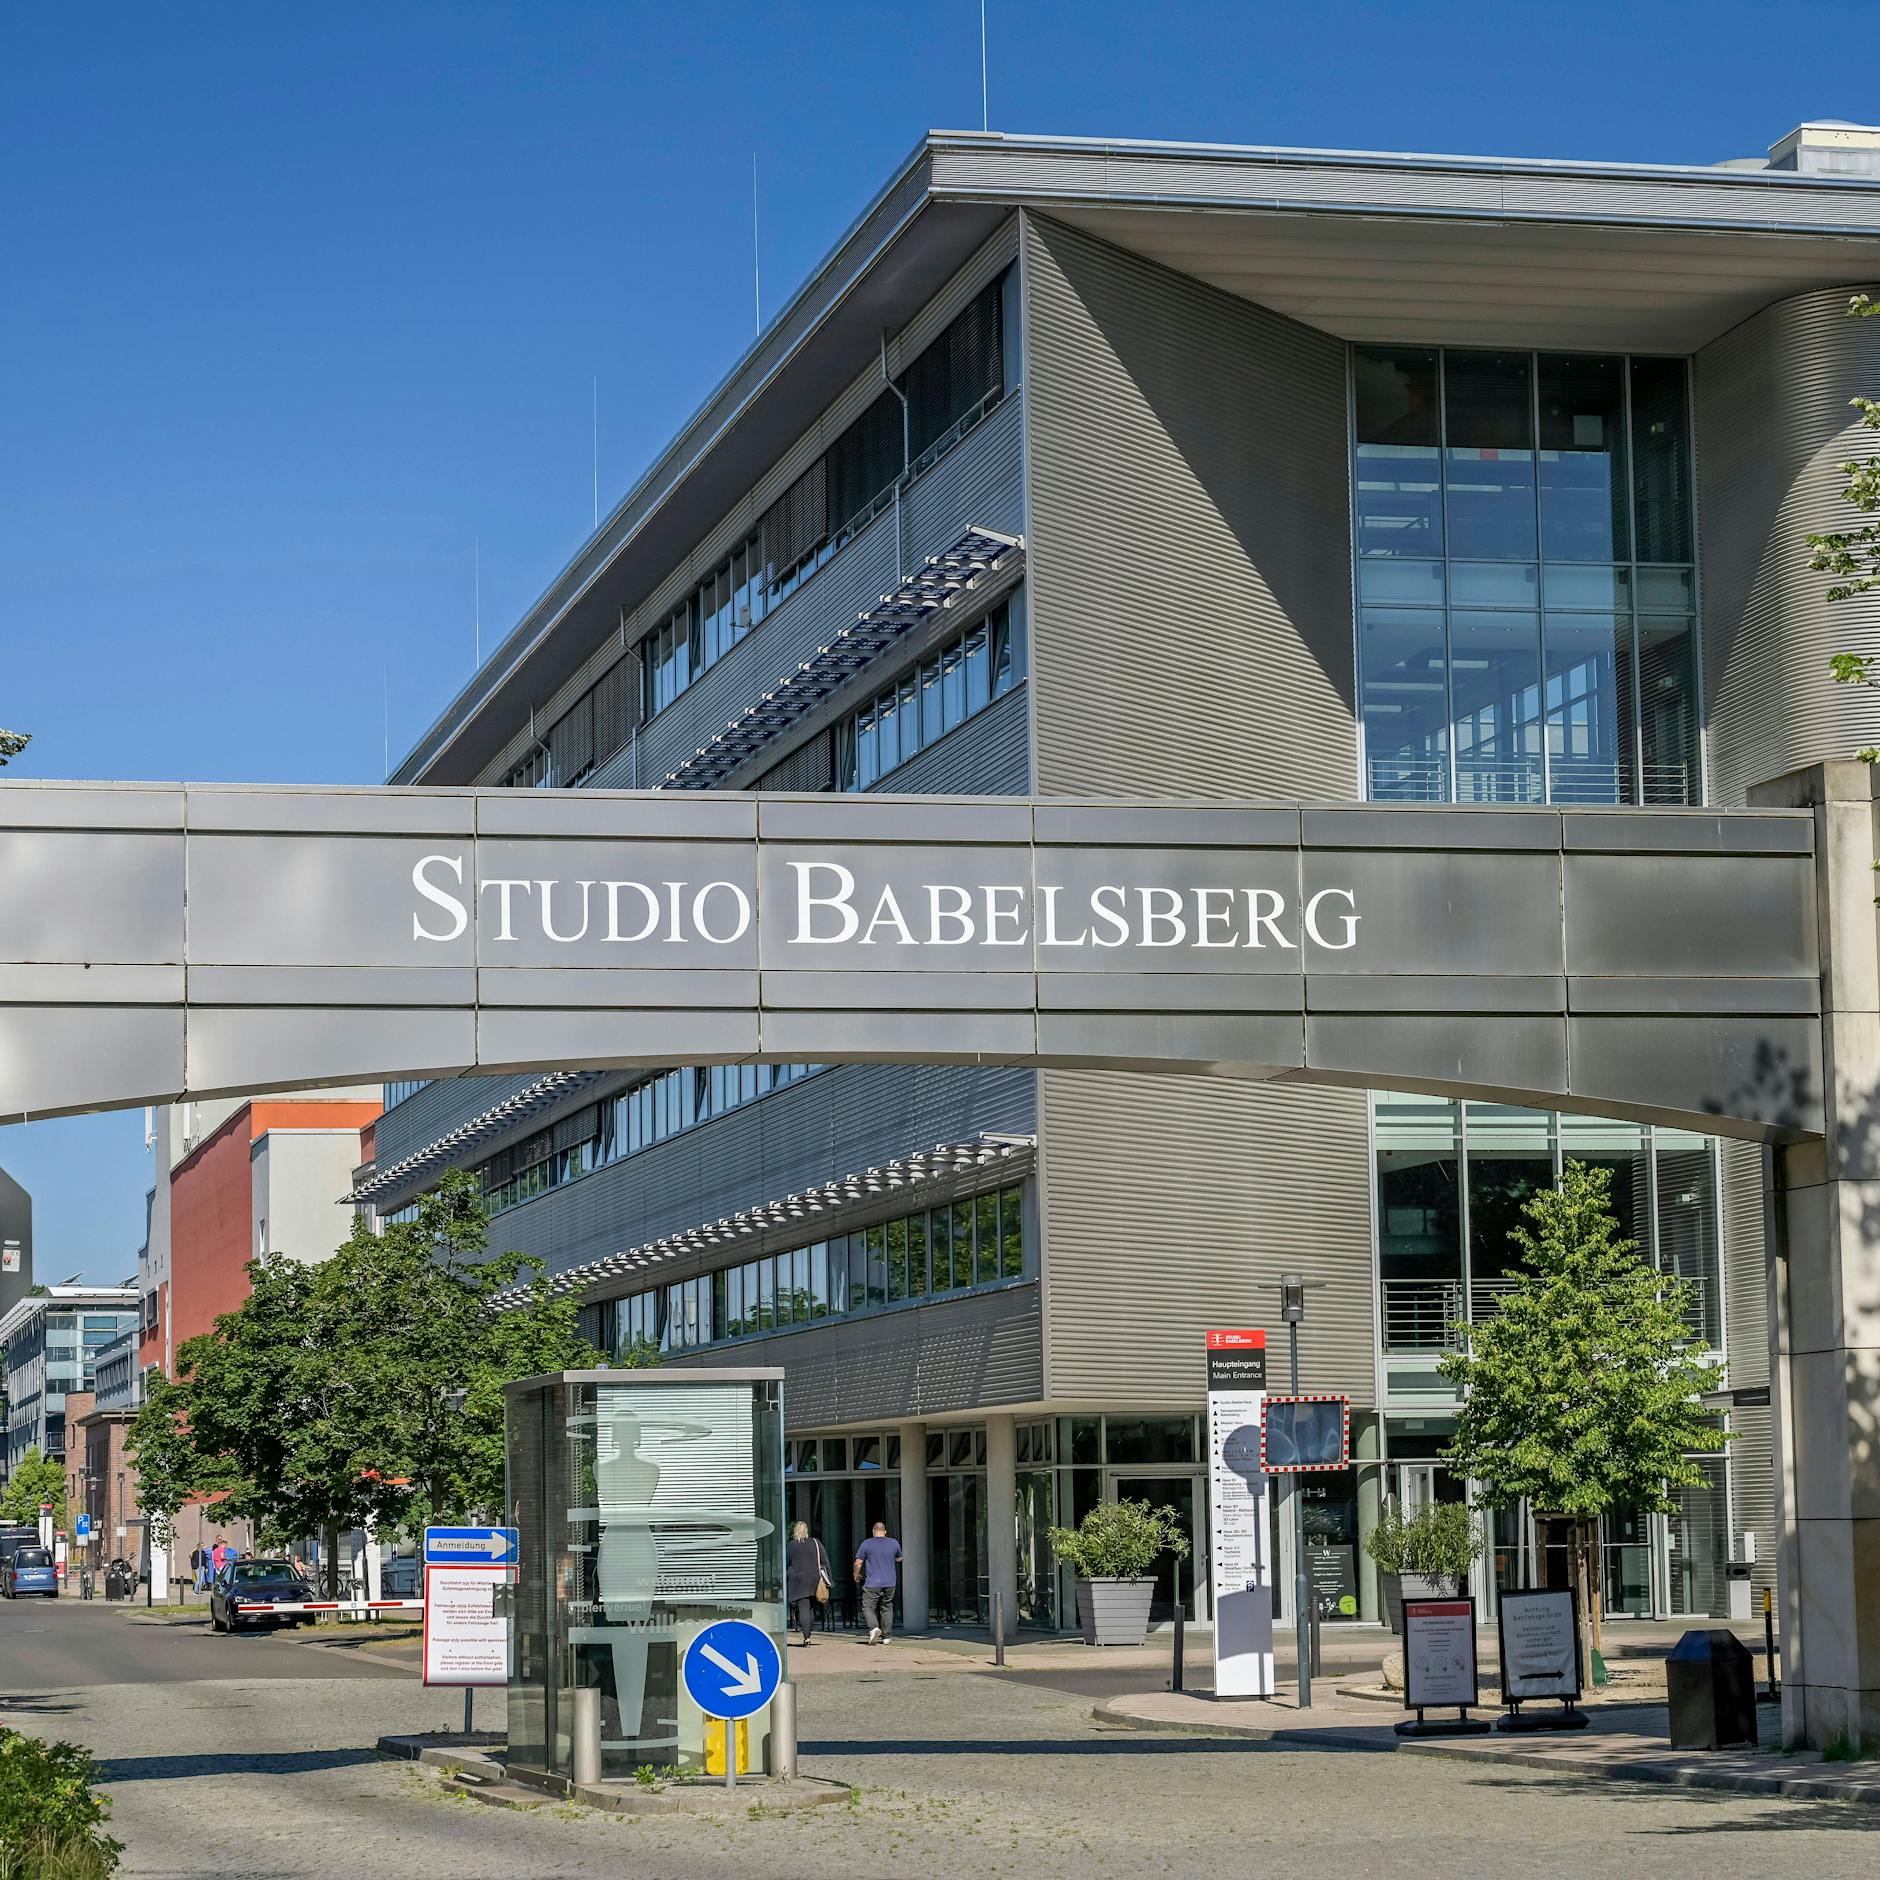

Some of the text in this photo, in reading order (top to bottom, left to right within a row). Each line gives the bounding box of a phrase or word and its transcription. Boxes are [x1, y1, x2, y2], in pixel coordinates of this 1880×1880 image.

[412, 855, 1362, 950] STUDIO BABELSBERG
[1212, 1360, 1261, 1369] Haupteingang
[1232, 1371, 1263, 1379] Entrance
[436, 1541, 486, 1551] Anmeldung
[581, 1601, 646, 1614] bienvenue!
